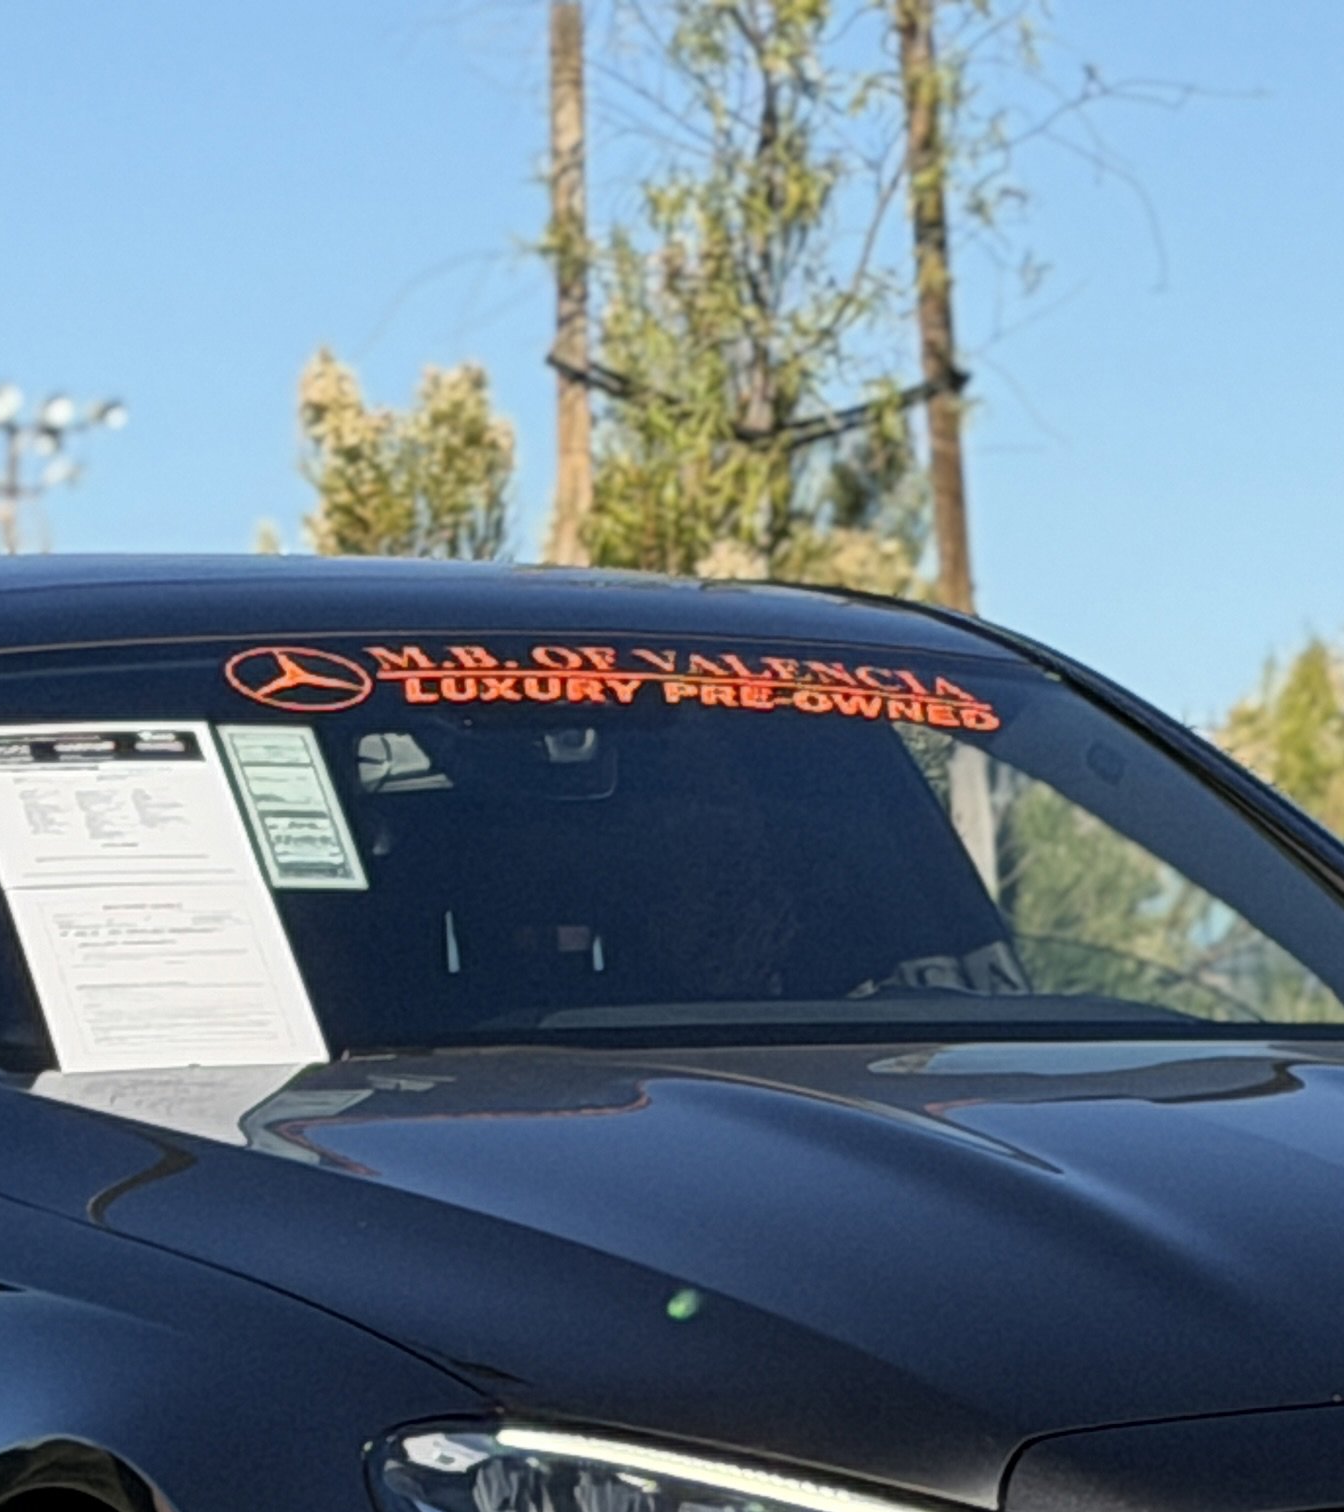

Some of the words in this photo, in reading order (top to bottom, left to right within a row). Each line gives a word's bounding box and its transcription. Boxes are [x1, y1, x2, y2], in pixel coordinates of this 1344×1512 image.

[361, 645, 519, 670] M.B.
[531, 646, 617, 671] OF
[631, 649, 975, 701] VALENCIA
[406, 677, 641, 704] LUXURY
[663, 682, 1001, 730] PRE-OWNED
